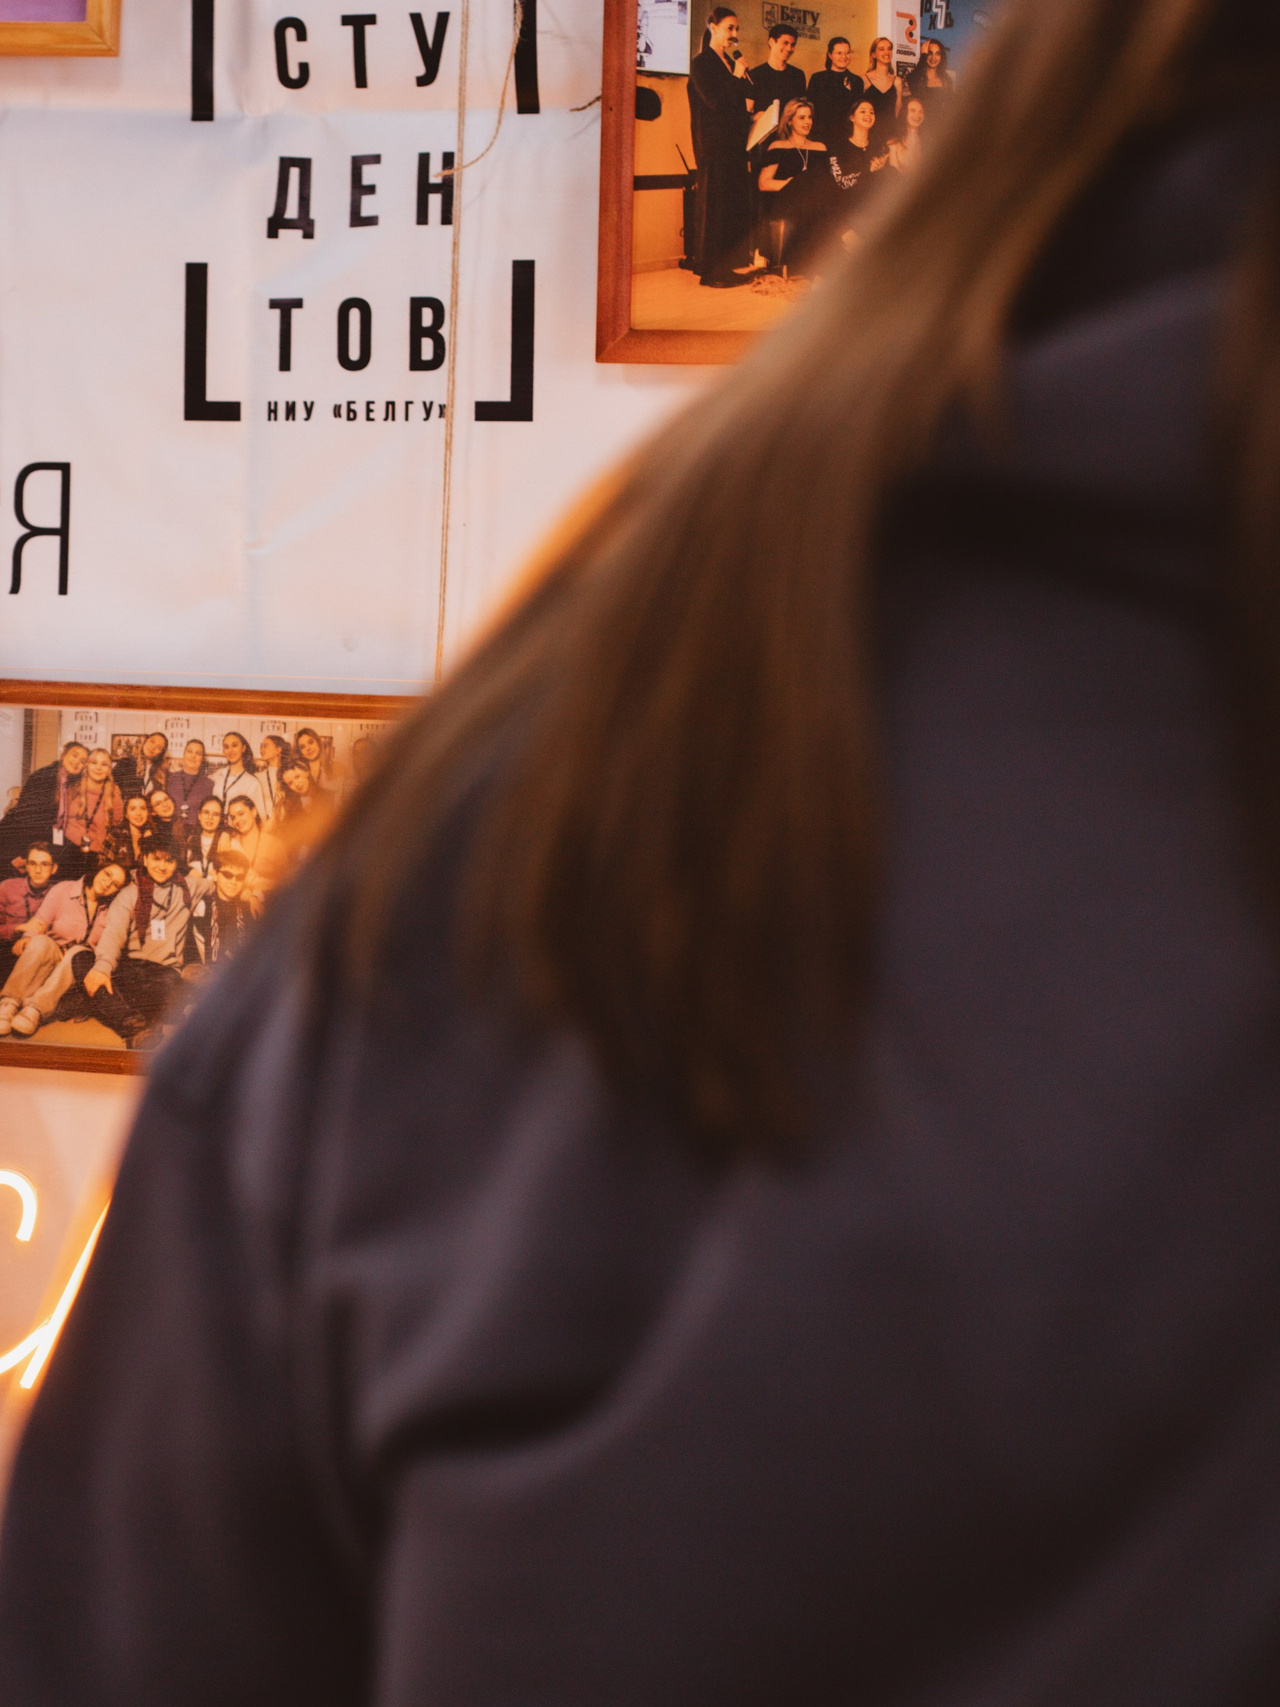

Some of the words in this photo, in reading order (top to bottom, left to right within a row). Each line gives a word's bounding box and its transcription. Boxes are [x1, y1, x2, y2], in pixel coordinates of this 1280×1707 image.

[273, 11, 450, 90] СТУ
[267, 151, 455, 239] ДЕН
[269, 297, 446, 372] ТОВ
[267, 400, 315, 422] НИУ
[333, 400, 447, 422] «БЕЛГУ»
